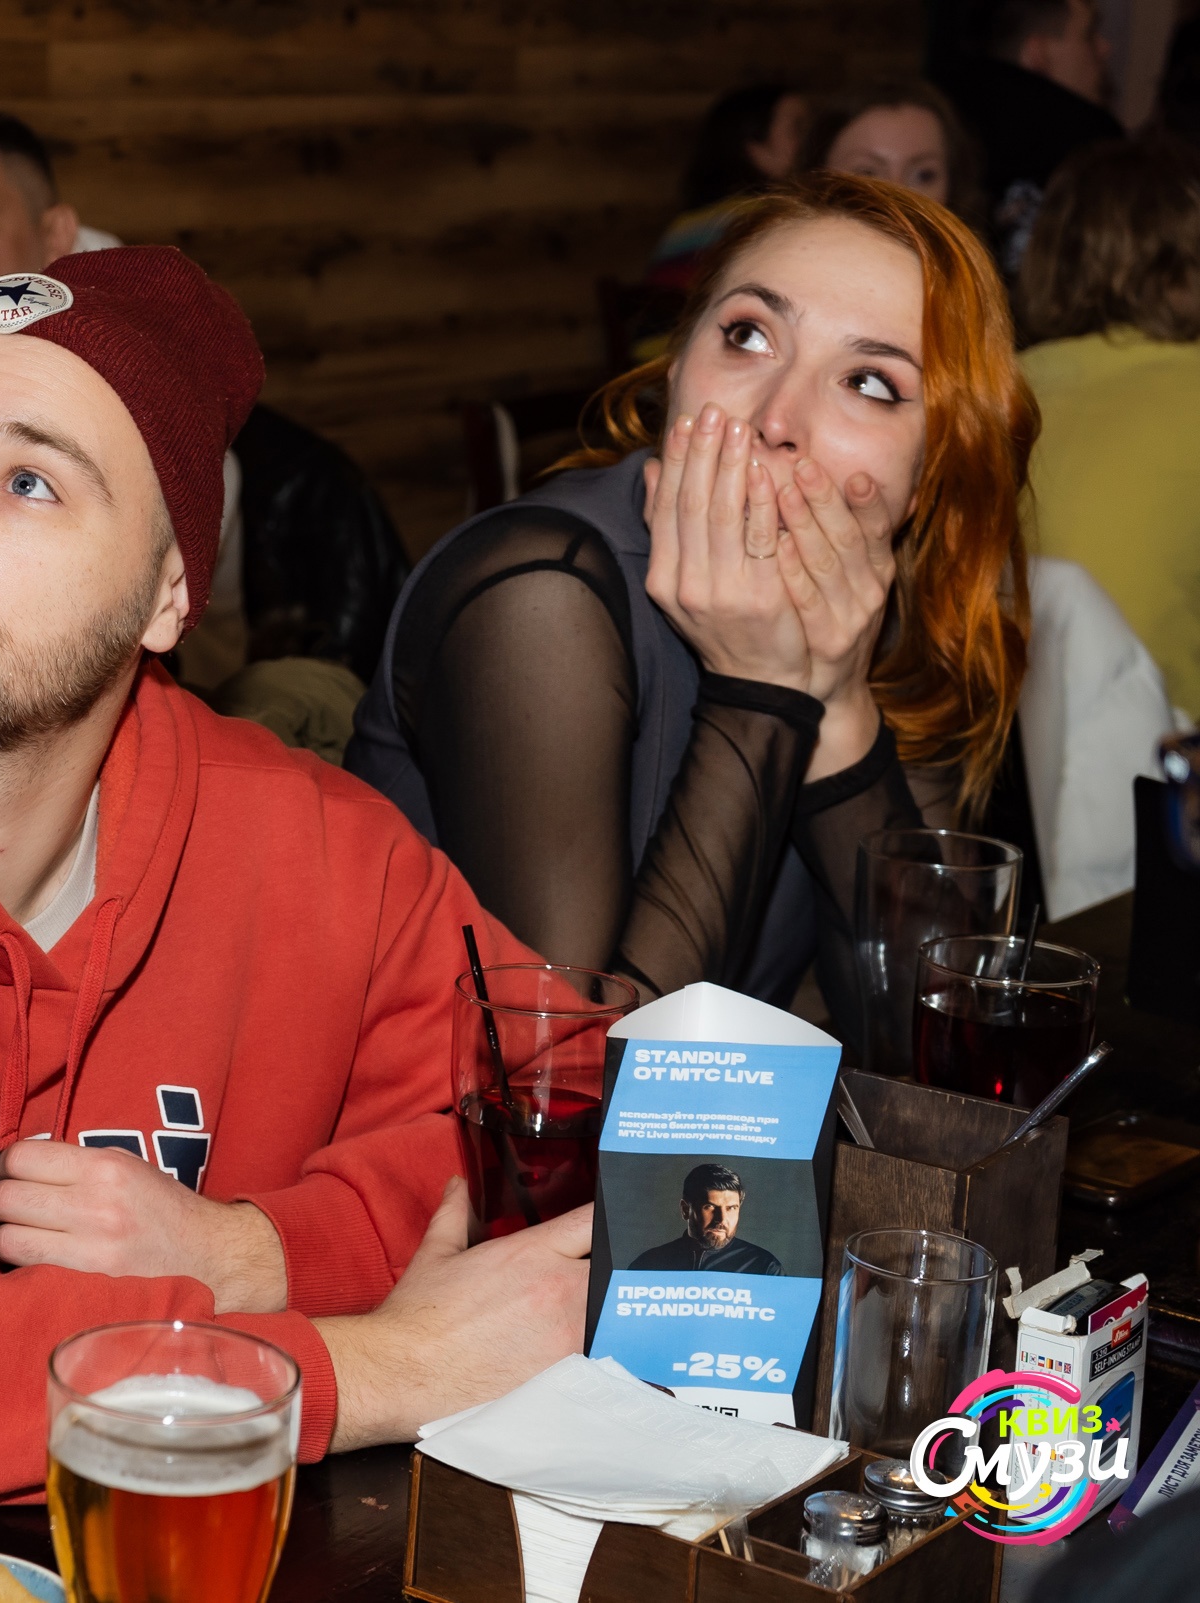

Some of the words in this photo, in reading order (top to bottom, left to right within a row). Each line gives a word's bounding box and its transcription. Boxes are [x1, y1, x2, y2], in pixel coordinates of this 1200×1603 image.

[634, 1049, 747, 1066] STANDUP
[633, 1066, 666, 1080] ОТ
[670, 1067, 720, 1083] МТС
[724, 1070, 774, 1085] LIVE
[618, 1120, 667, 1130] покупке
[669, 1121, 710, 1130] билета
[726, 1123, 762, 1133] сайте
[696, 1113, 755, 1123] промокод
[757, 1116, 779, 1125] при
[646, 1130, 670, 1139] Live
[733, 1134, 777, 1145] скидку
[617, 1285, 752, 1305] ПРОМОКОД
[672, 1352, 786, 1383] -25%
[1094, 1347, 1126, 1374] SELF-INKING
[1180, 1428, 1200, 1462] ЗАМЕТО
[1171, 1459, 1192, 1479] ДЛЯ
[1158, 1475, 1181, 1499] ЛИСТ
